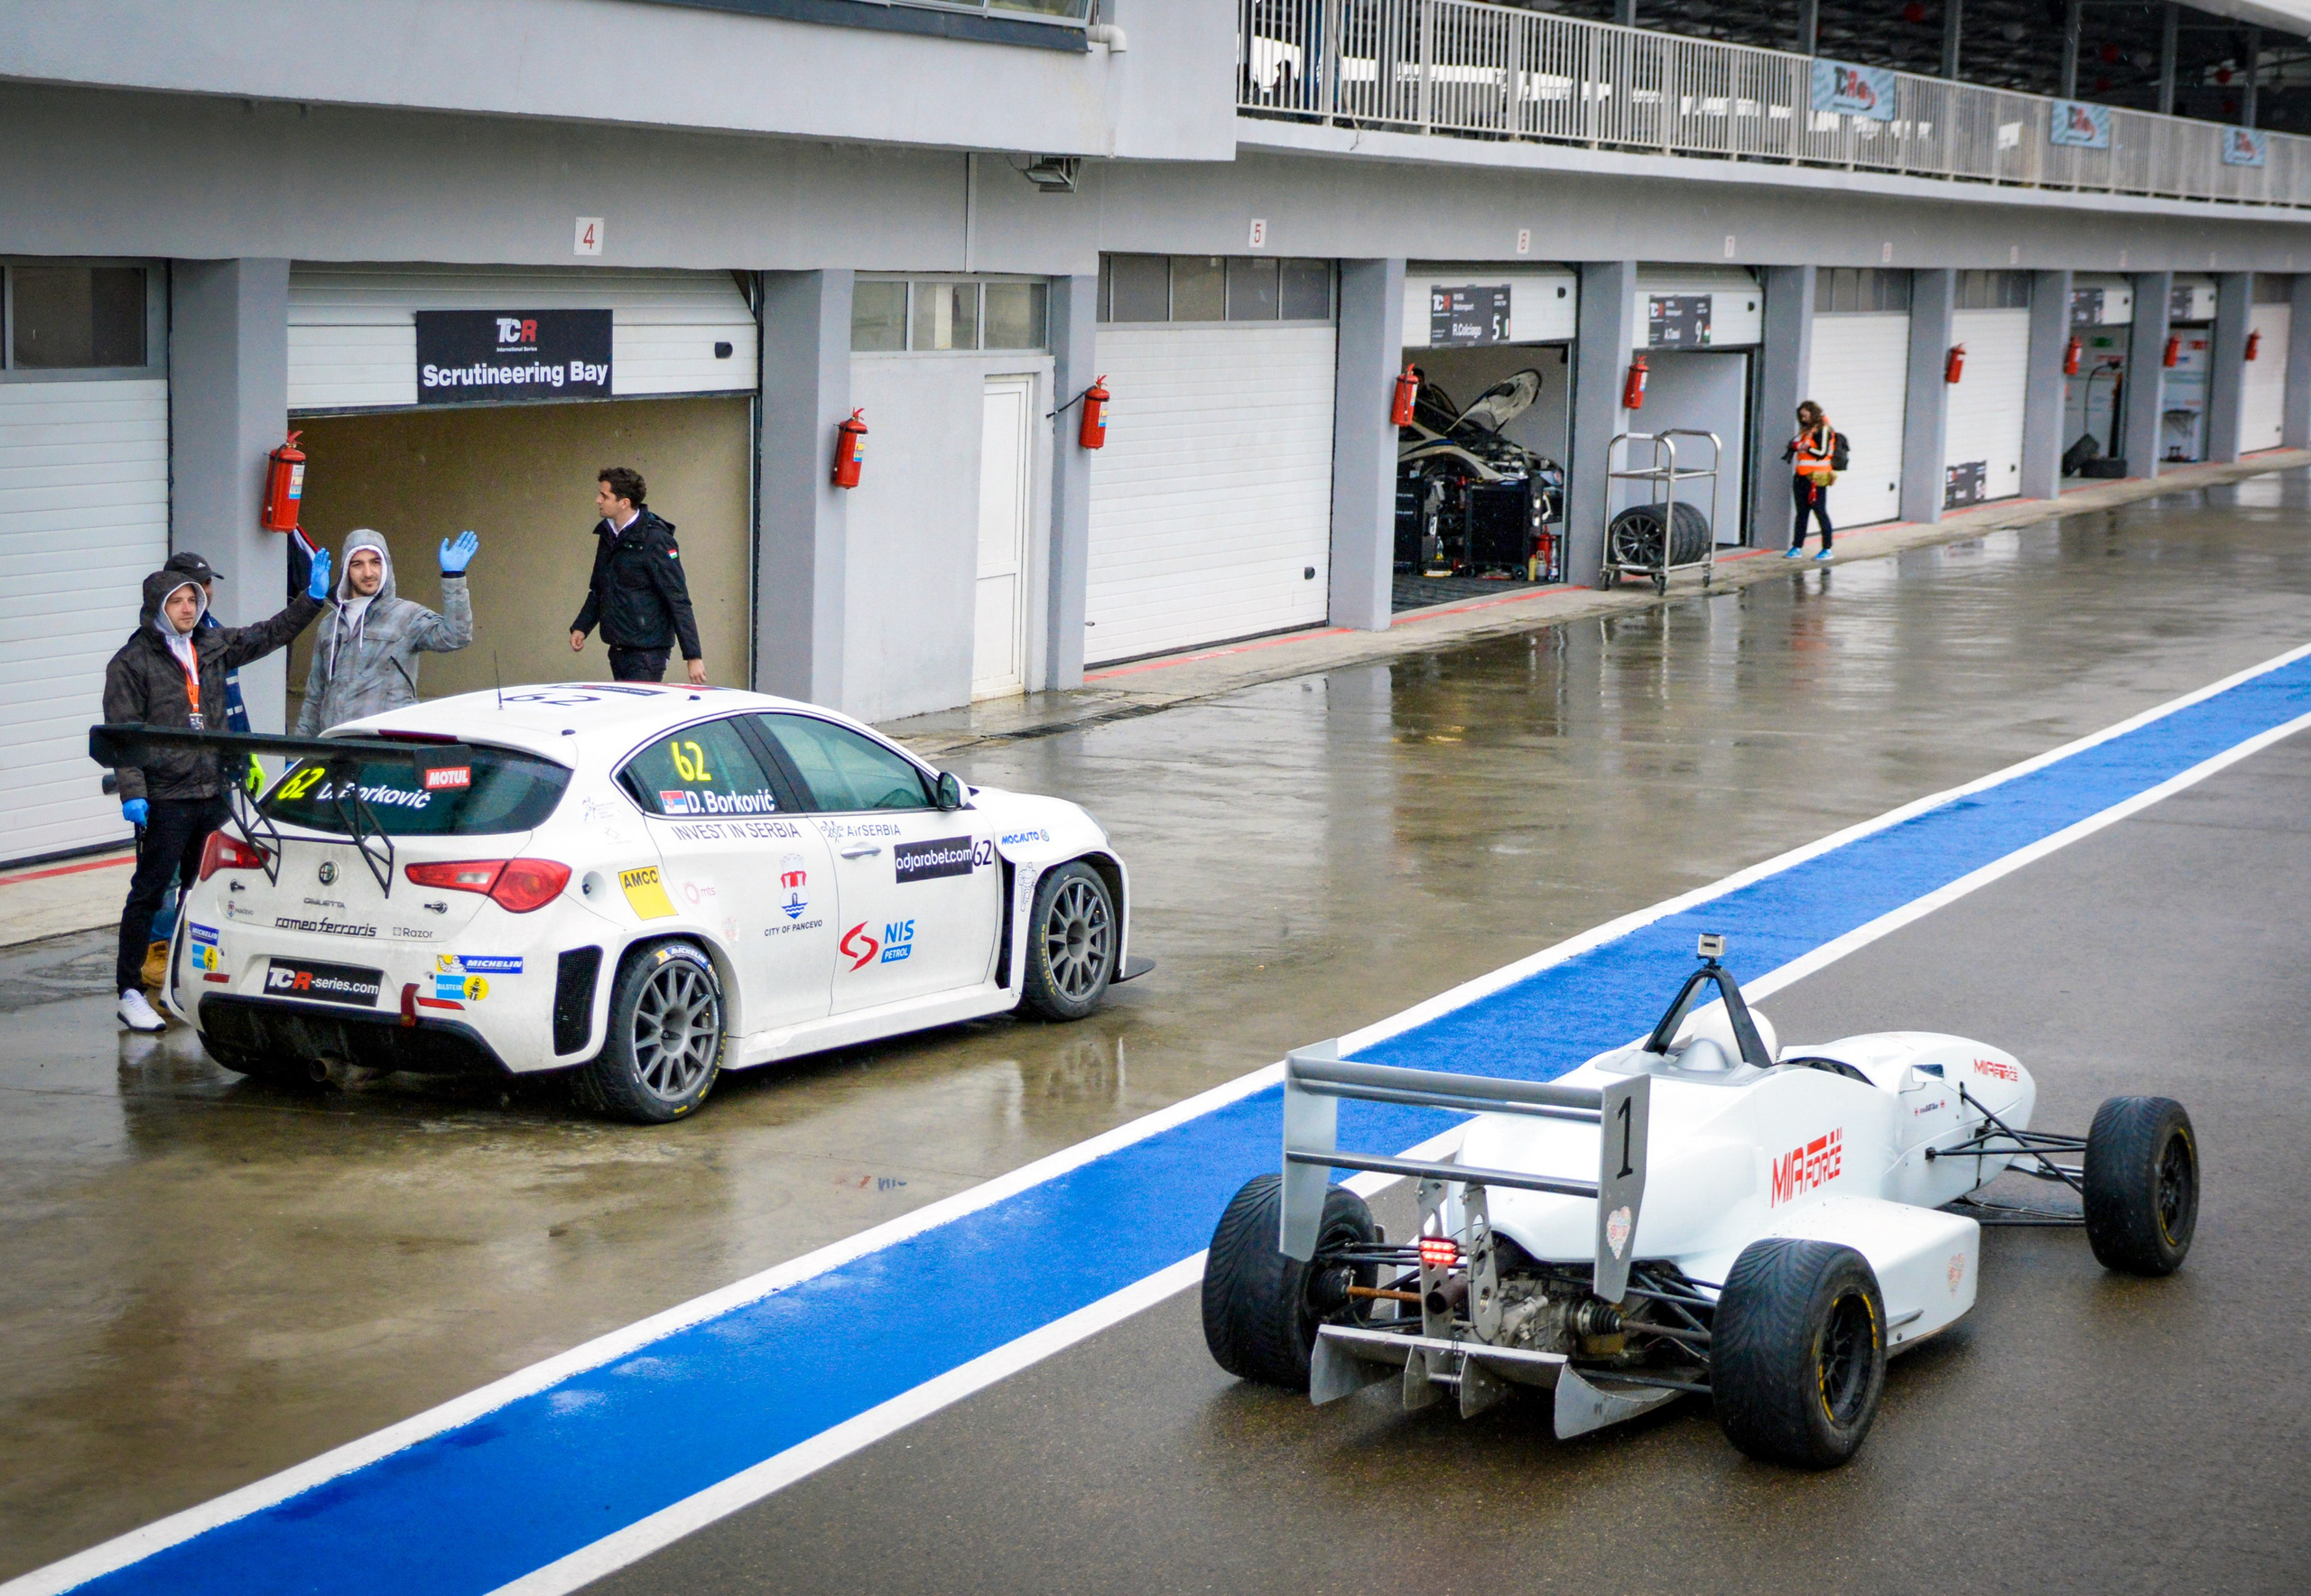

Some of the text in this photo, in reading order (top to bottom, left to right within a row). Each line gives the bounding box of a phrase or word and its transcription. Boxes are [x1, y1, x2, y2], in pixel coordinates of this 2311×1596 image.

[583, 223, 594, 249] 4
[1254, 223, 1261, 243] 5
[497, 319, 538, 343] TCR
[1492, 315, 1499, 340] 5
[1695, 320, 1703, 343] 9
[423, 361, 608, 387] Scrutineering Bay
[673, 741, 712, 781] 62
[278, 767, 325, 800] 62
[429, 770, 468, 785] MOTUL
[685, 789, 775, 813] D. Borković
[671, 821, 803, 840] INVEST IN SERBIA
[1001, 830, 1040, 846] MOCAUTO
[896, 846, 972, 872] adjarabet.com
[972, 840, 993, 868] 62
[623, 869, 659, 889] AMCC
[700, 886, 716, 896] mts
[192, 927, 218, 939] MICHELIN
[275, 917, 317, 932] romeo
[403, 928, 433, 939] Razor
[765, 919, 823, 937] CITY OF PANCEVO
[885, 919, 915, 944] NIS
[467, 960, 523, 968] MICHELIN
[671, 947, 707, 964] MICHELIN
[884, 947, 909, 960] PETROL
[268, 968, 379, 995] TCR-series.com
[437, 982, 464, 991] BILSTEIN
[1616, 1096, 1634, 1181] 1
[1771, 1144, 1842, 1209] MIA FORCE
